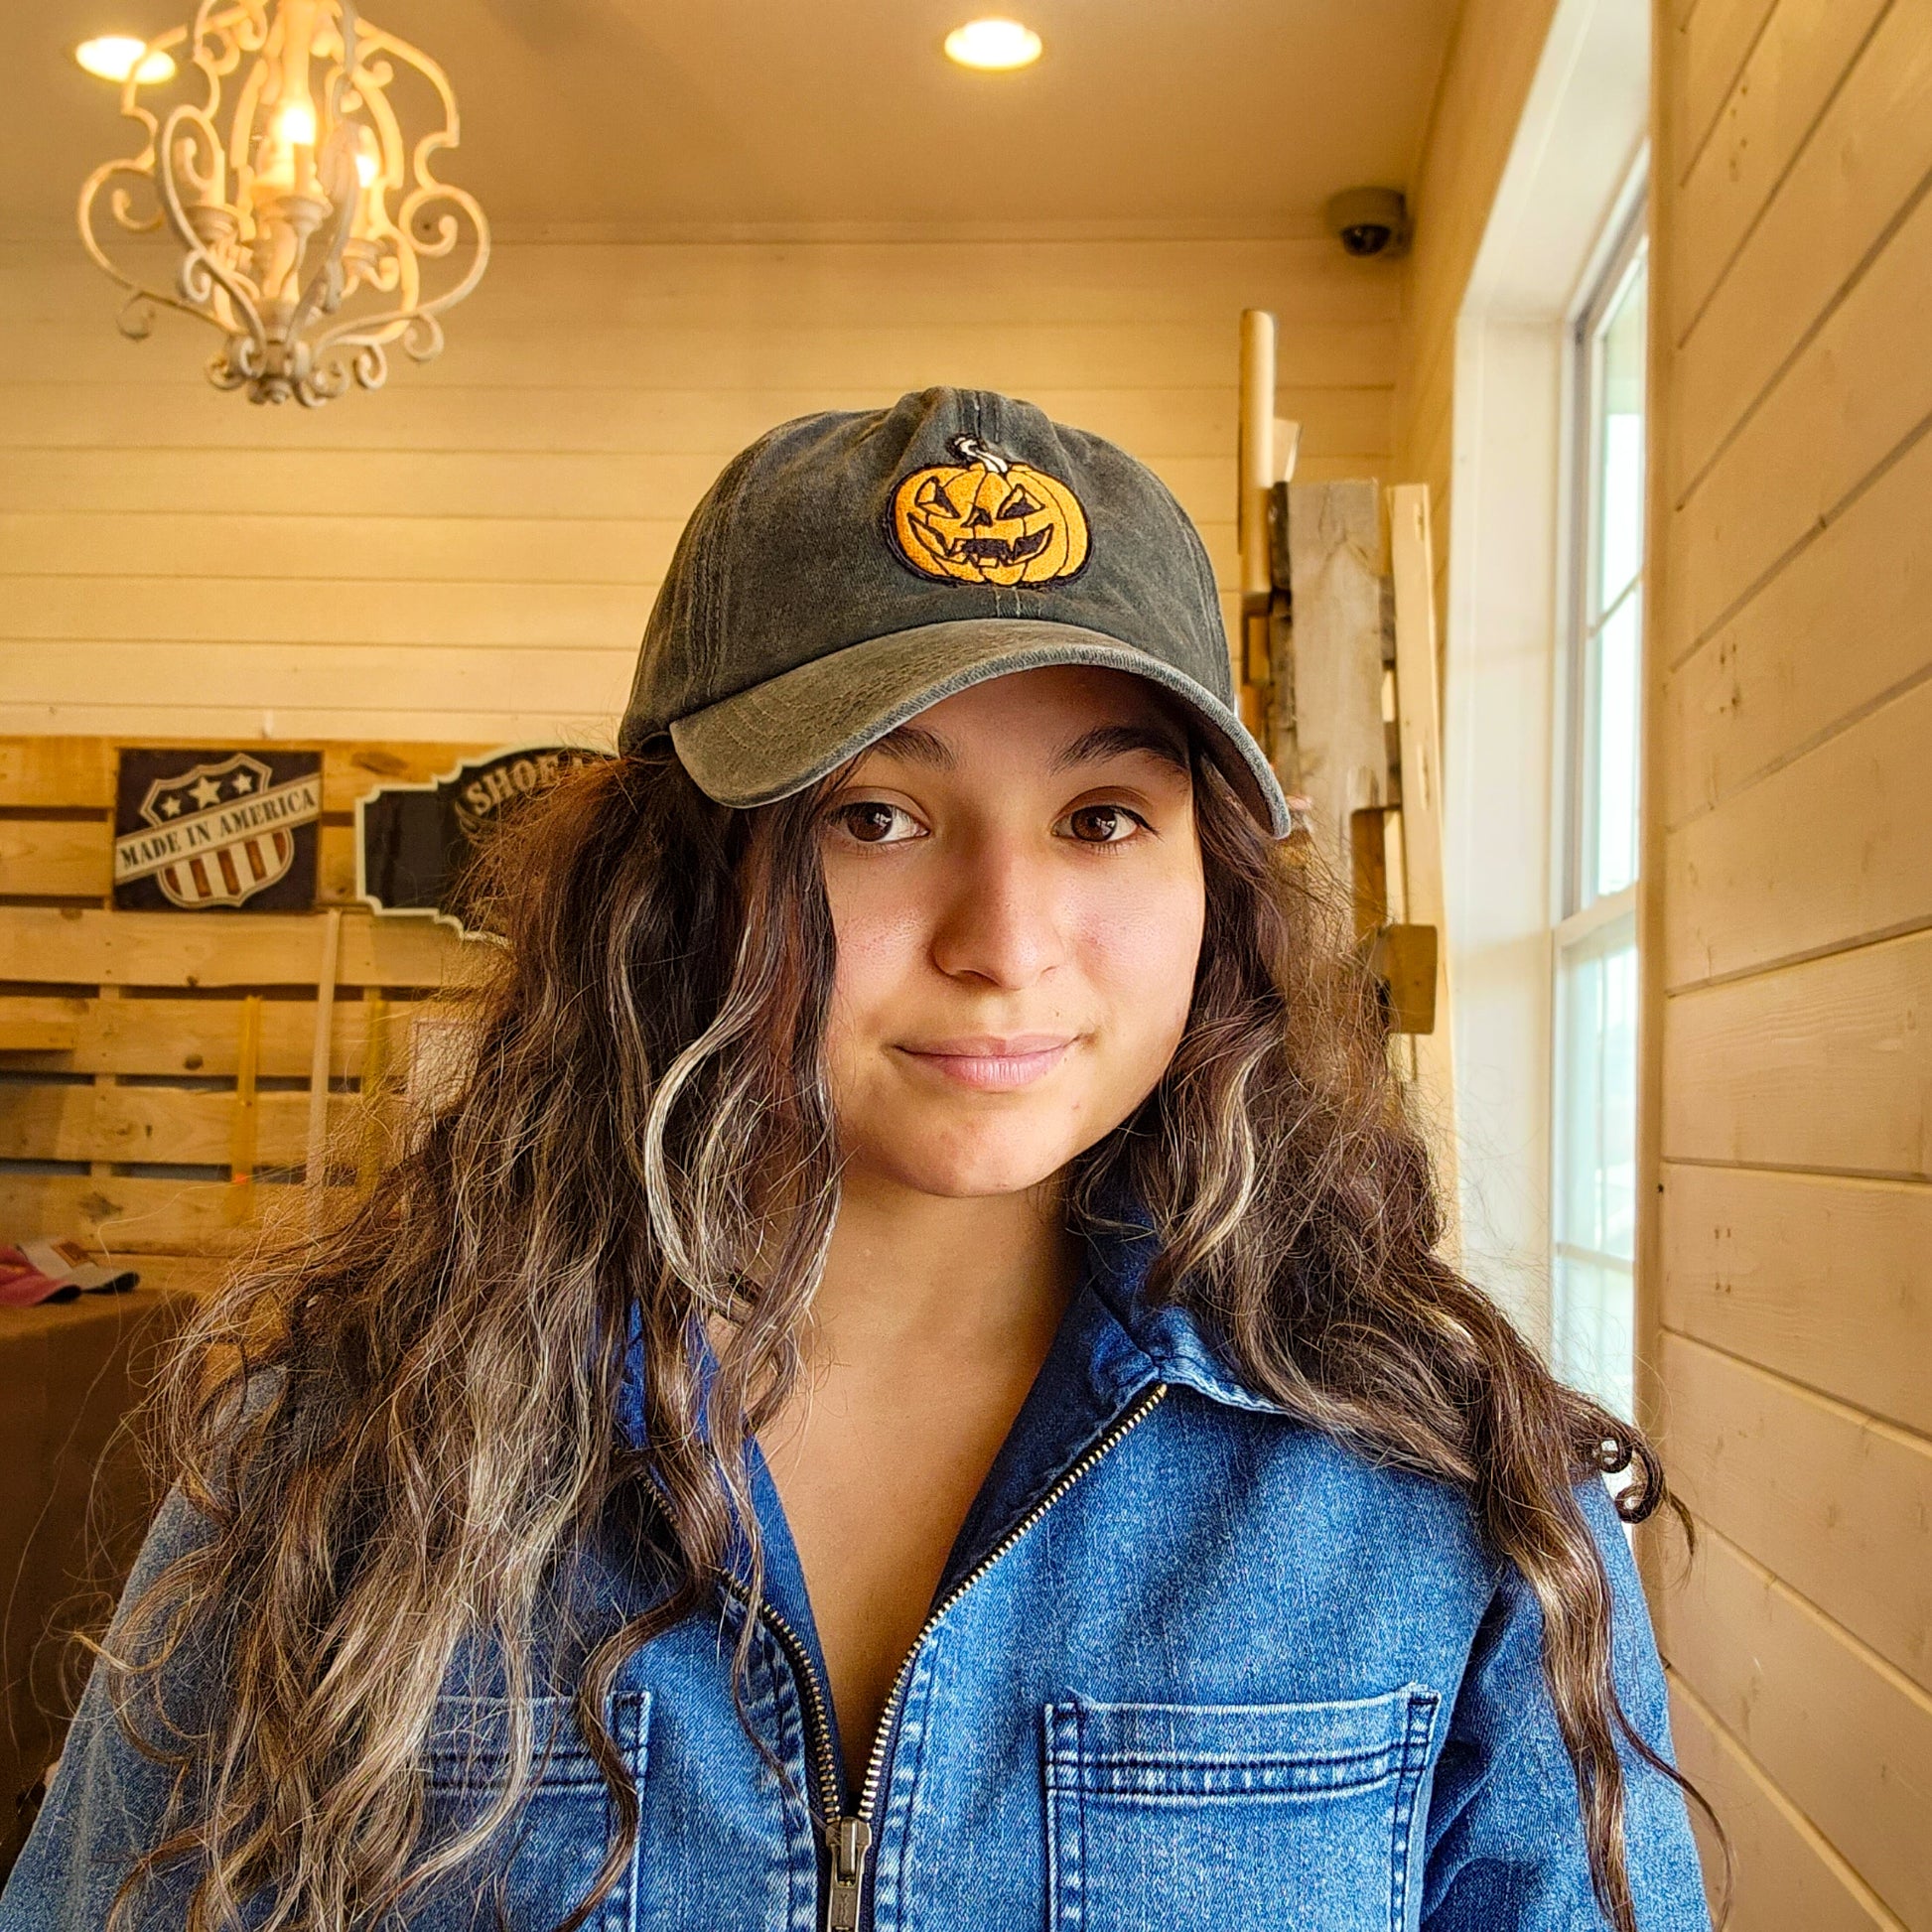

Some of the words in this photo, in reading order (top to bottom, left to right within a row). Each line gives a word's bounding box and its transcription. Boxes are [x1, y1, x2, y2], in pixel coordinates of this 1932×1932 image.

[118, 830, 182, 869] MADE
[186, 822, 212, 847] IN
[218, 786, 317, 839] AMERICA
